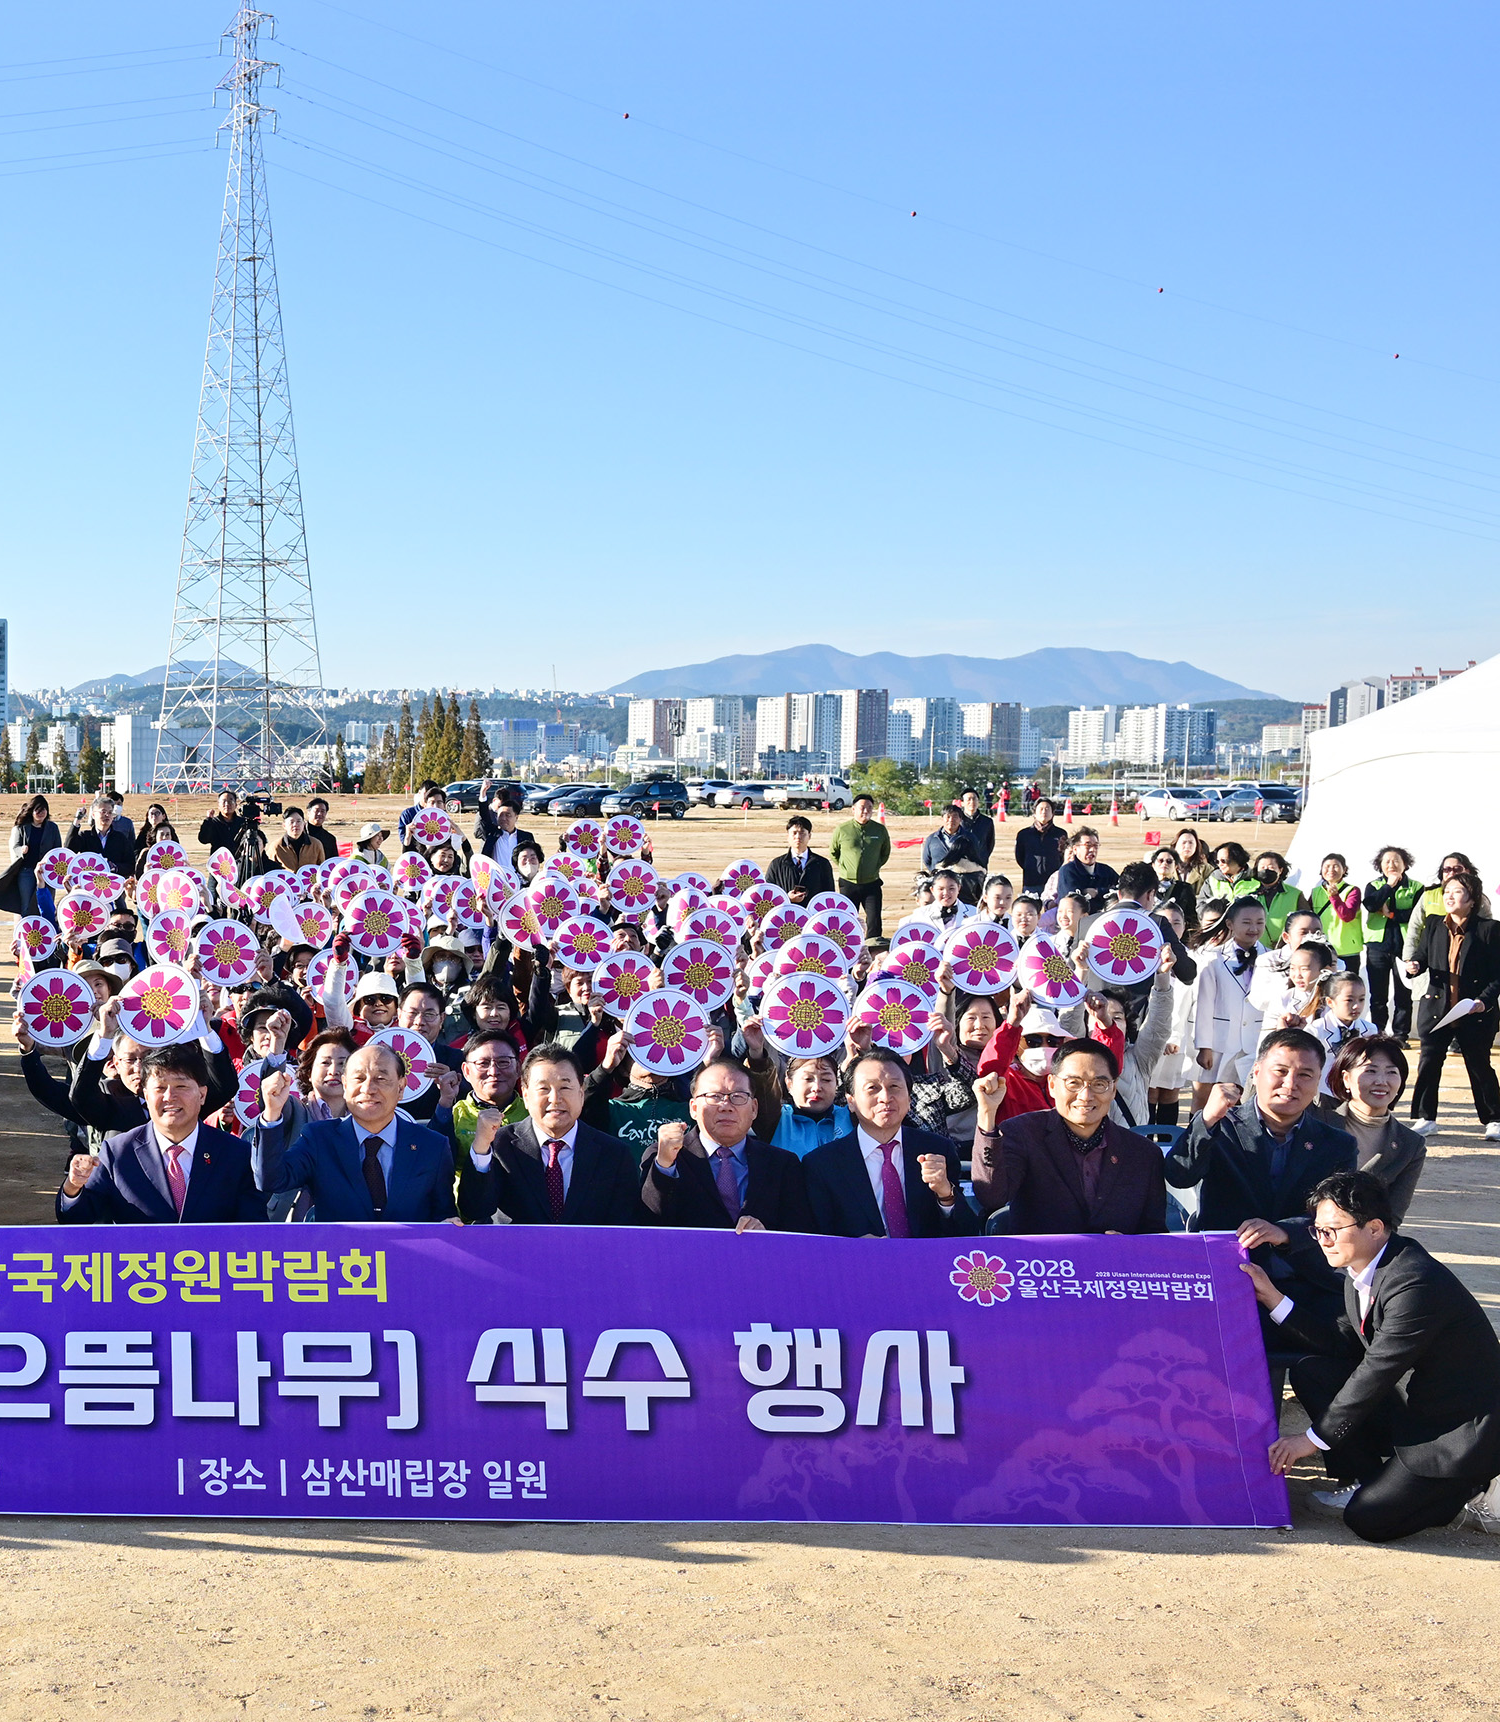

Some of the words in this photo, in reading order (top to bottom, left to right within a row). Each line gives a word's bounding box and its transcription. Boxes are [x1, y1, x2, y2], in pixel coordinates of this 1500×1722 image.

[1015, 1259, 1076, 1278] 2028
[1017, 1279, 1214, 1301] 울산국제정원박람회
[466, 1328, 690, 1431] 식수
[734, 1322, 965, 1434] 행사
[199, 1458, 267, 1496] 장소
[301, 1458, 472, 1499] 삼산매립장
[483, 1461, 548, 1500] 일원
